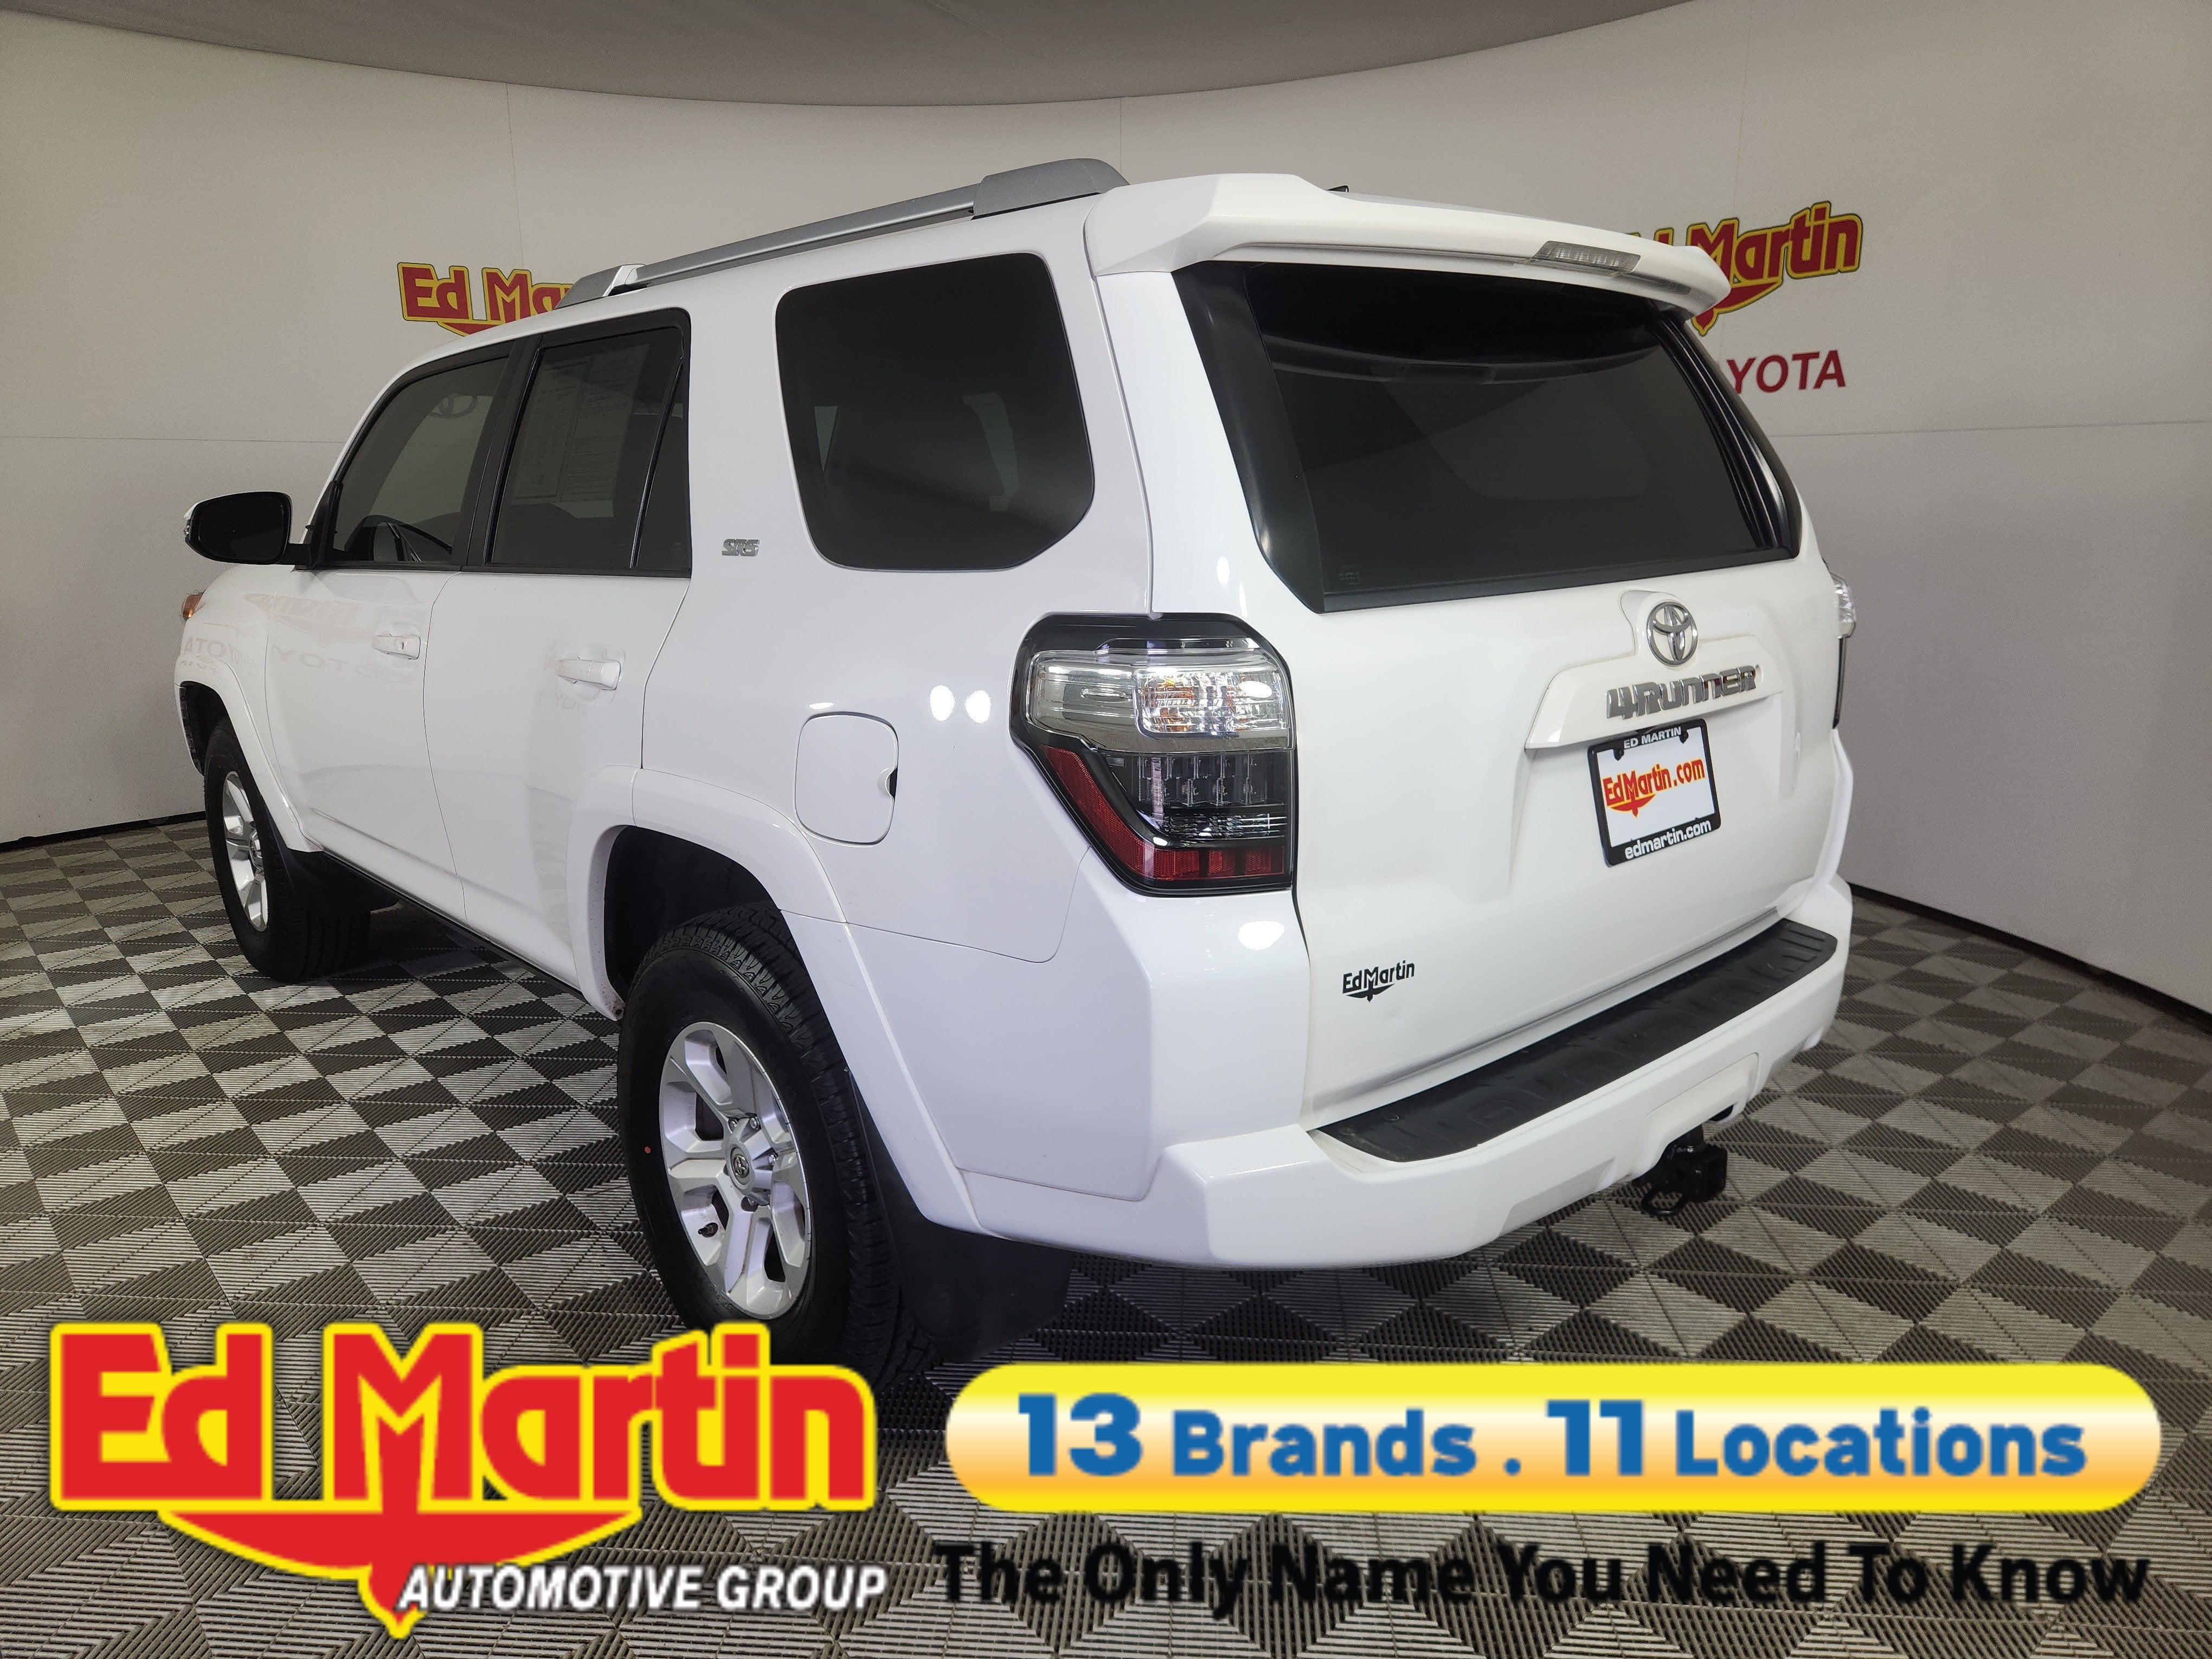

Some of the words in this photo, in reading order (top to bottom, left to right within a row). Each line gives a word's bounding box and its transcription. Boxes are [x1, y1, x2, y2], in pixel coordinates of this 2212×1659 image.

[397, 262, 472, 322] Ed
[722, 538, 760, 556] SR5
[1606, 665, 1757, 720] 4RUNNER
[1624, 738, 1638, 749] ED
[1641, 726, 1682, 745] MARTIN
[1625, 820, 1712, 860] edmartin.com
